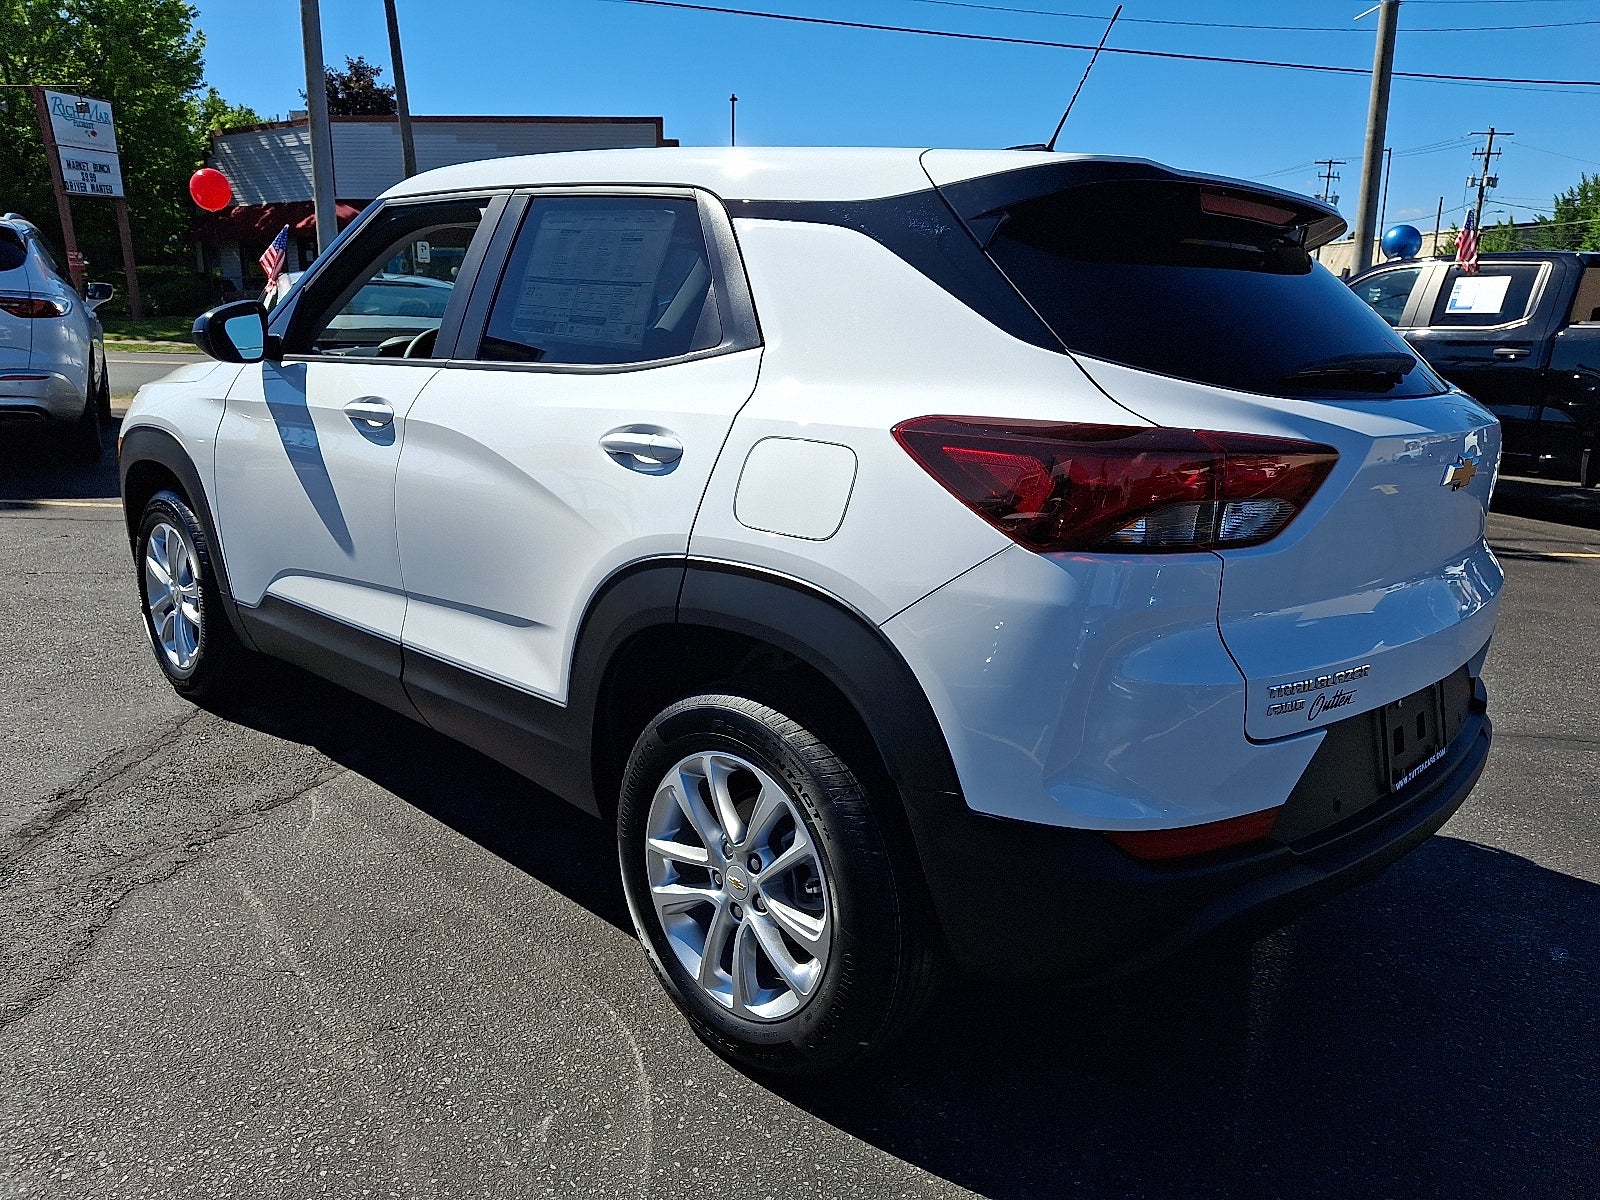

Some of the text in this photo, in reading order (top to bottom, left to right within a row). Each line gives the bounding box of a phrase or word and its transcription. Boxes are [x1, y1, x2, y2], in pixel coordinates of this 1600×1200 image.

[66, 159, 89, 171] MARKET
[65, 180, 113, 194] DRIVER WANTED
